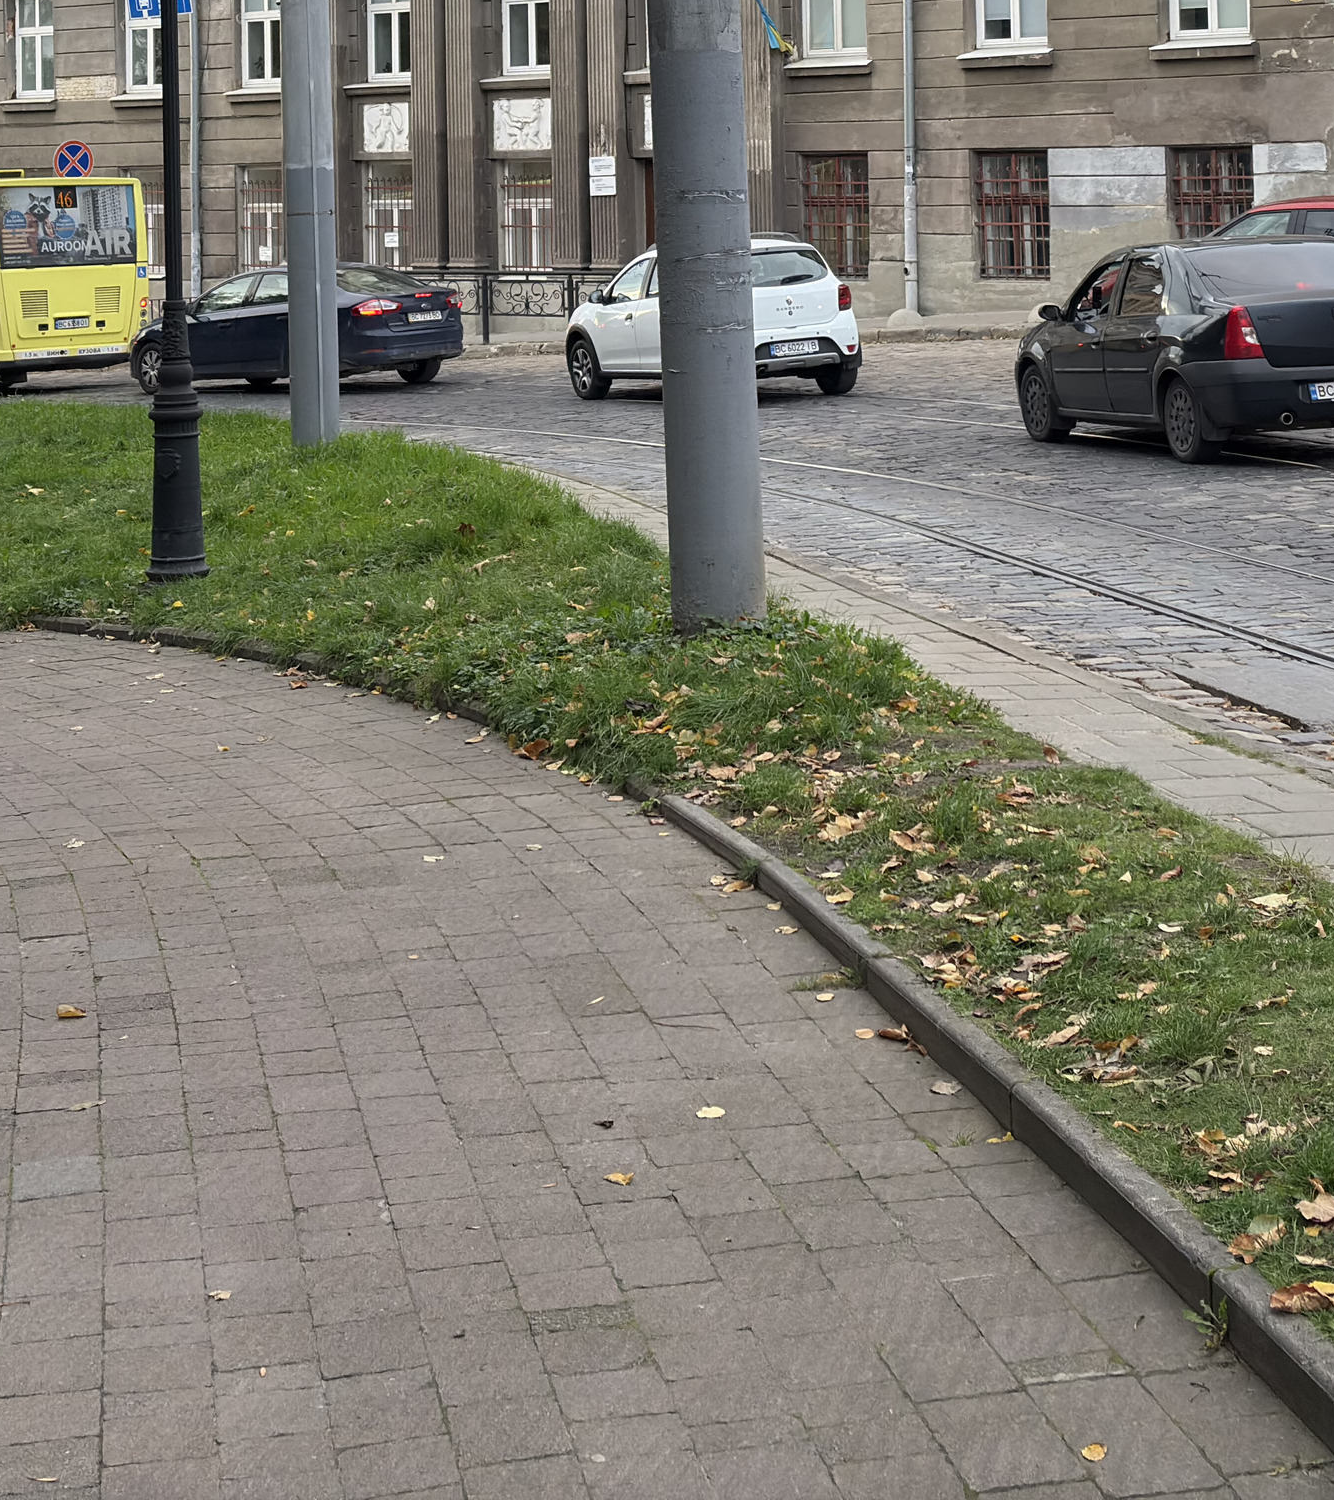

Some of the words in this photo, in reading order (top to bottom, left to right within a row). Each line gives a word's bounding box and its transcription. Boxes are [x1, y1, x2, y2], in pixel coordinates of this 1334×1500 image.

[56, 190, 74, 208] 46
[775, 344, 786, 353] BC
[788, 342, 805, 352] 6022
[808, 341, 817, 350] IB
[1317, 384, 1334, 397] BC
